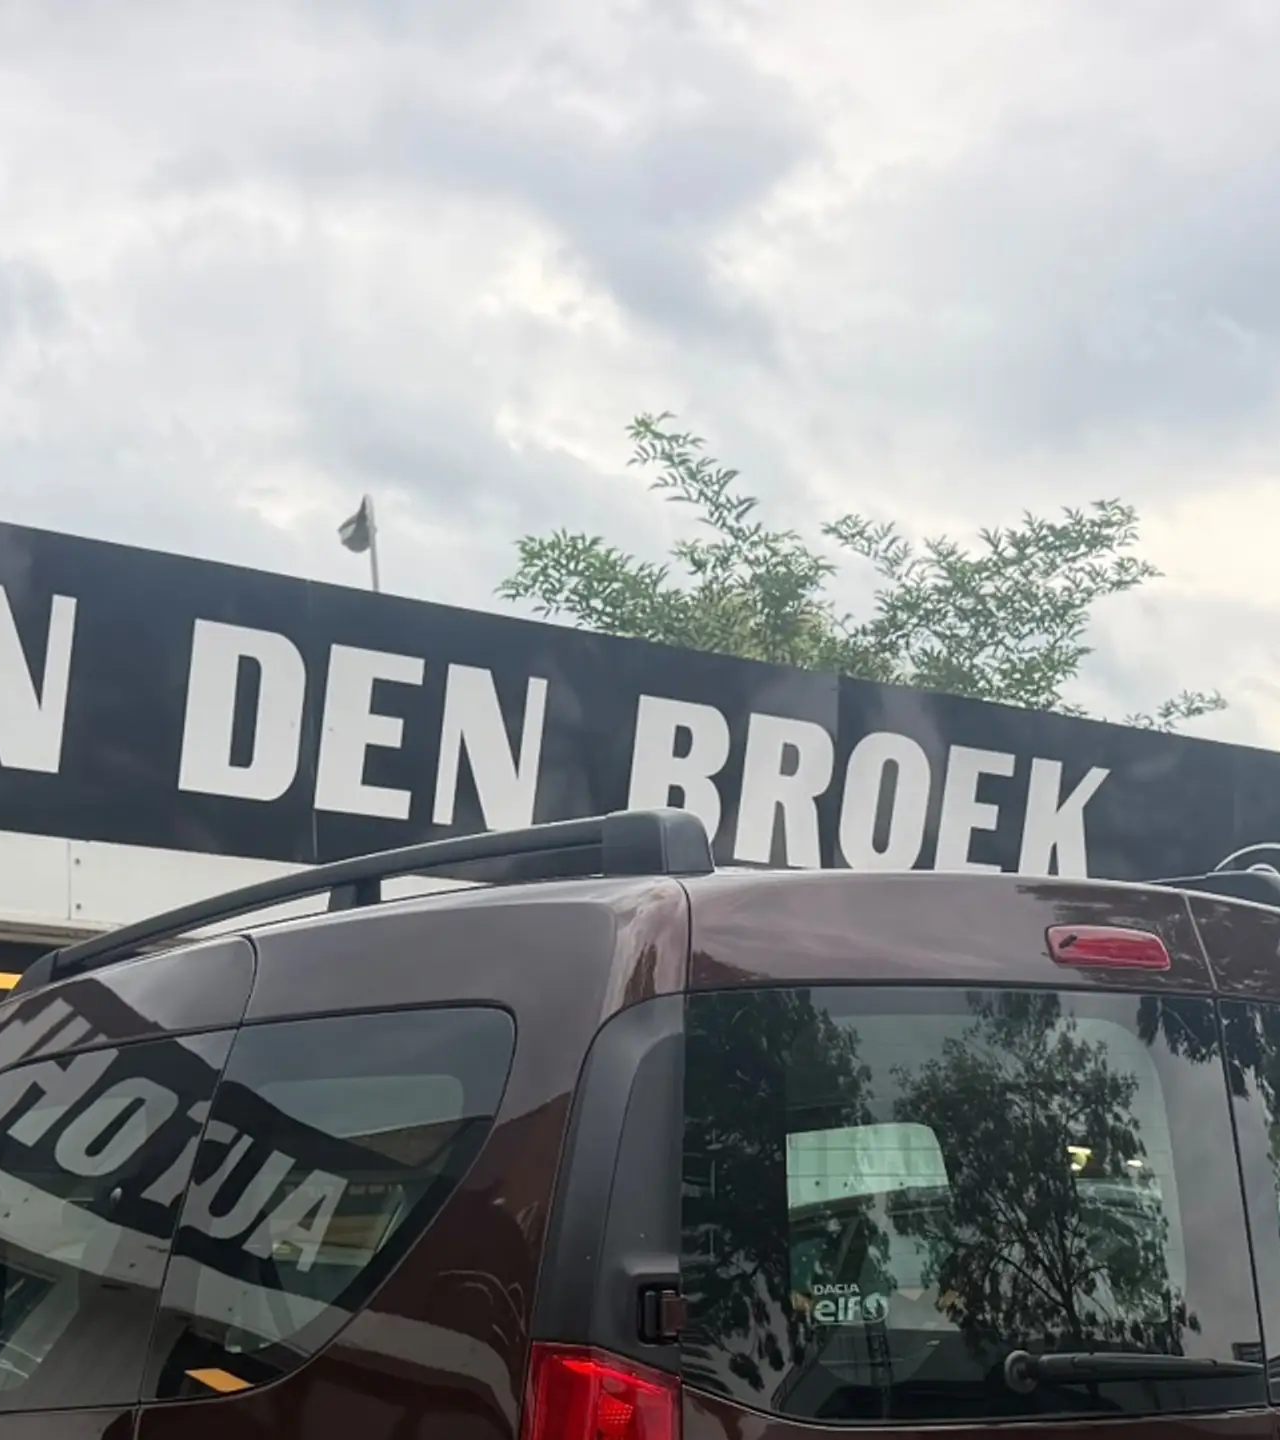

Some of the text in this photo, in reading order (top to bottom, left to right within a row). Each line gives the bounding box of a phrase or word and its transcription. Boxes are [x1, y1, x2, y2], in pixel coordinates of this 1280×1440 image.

[178, 617, 549, 832] DEN
[626, 693, 1112, 880] BROEK
[814, 1283, 860, 1296] DACIA
[814, 1296, 861, 1321] elf
